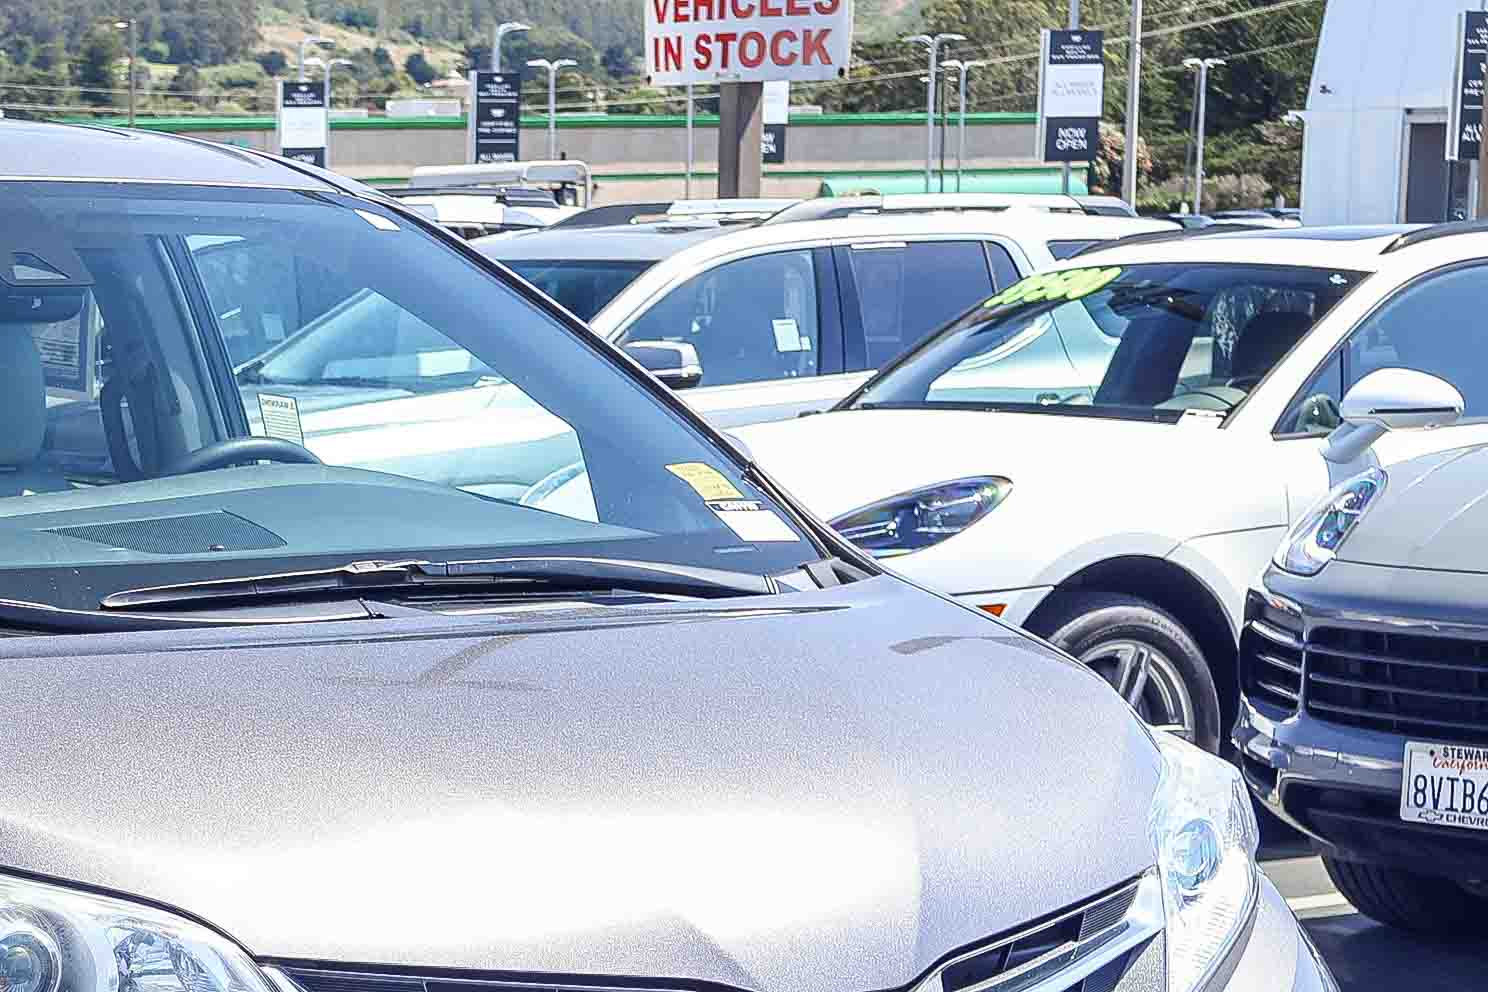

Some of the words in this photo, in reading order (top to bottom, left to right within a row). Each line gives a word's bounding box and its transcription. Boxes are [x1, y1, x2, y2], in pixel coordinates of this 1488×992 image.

[653, 35, 682, 72] IN
[693, 28, 833, 70] STOCK
[1057, 127, 1087, 139] NOW
[1055, 138, 1088, 151] OPEN
[1413, 774, 1488, 815] 8VIB6
[1446, 814, 1488, 826] CHEVR
